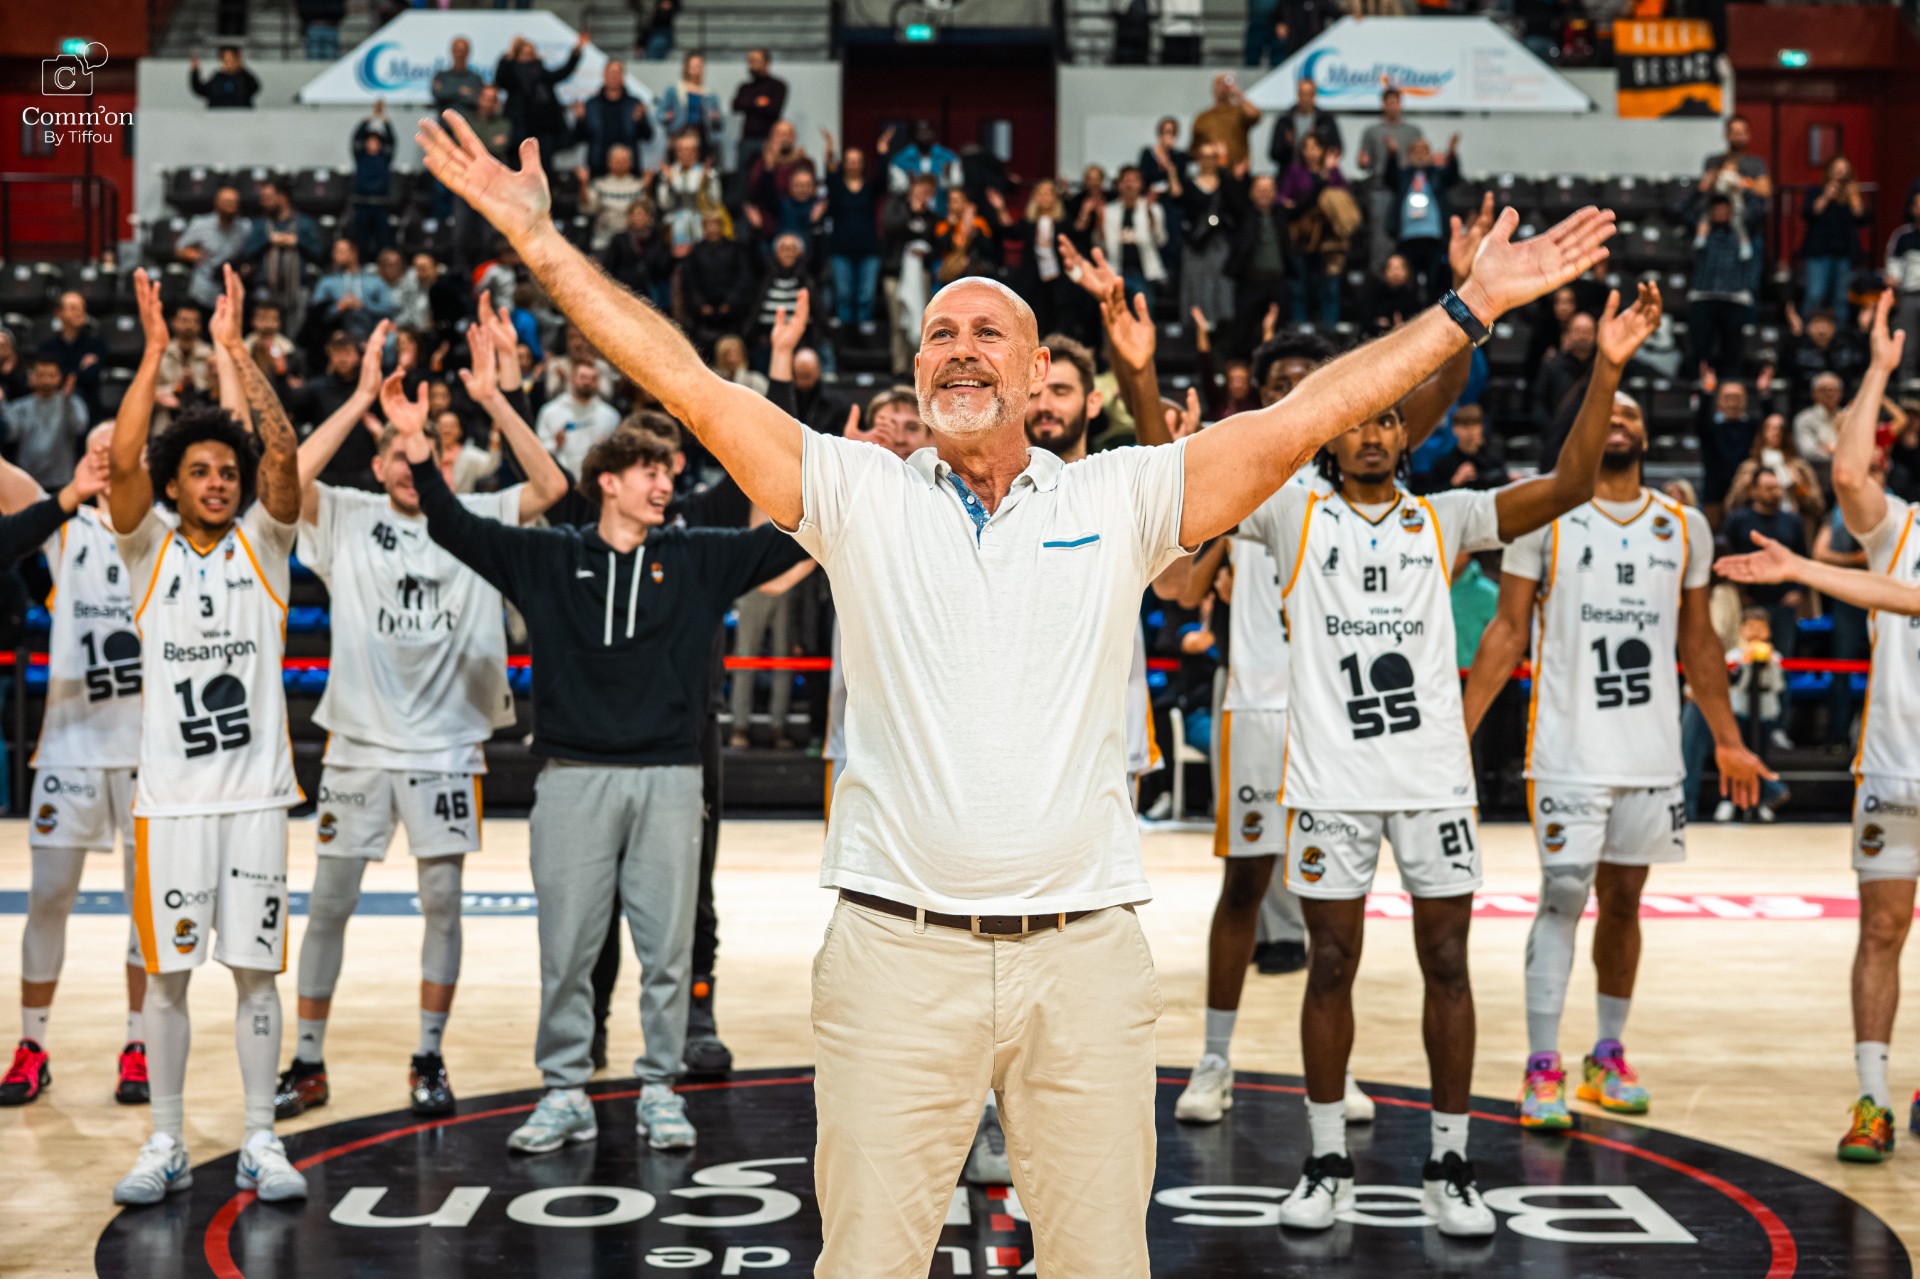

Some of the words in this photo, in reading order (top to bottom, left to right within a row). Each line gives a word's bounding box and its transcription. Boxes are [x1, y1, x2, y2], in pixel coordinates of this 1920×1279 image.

[371, 521, 398, 551] 46
[1363, 566, 1387, 592] 21
[1615, 562, 1635, 586] 12
[200, 595, 214, 618] 3
[1326, 615, 1423, 647] Besançon
[163, 640, 257, 669] Besançon
[85, 663, 141, 703] 55
[1594, 672, 1652, 709] 55
[1346, 691, 1422, 740] 55
[180, 708, 251, 759] 55
[434, 790, 469, 821] 46
[1439, 818, 1474, 856] 21
[262, 896, 280, 930] 3
[644, 1246, 791, 1276] de
